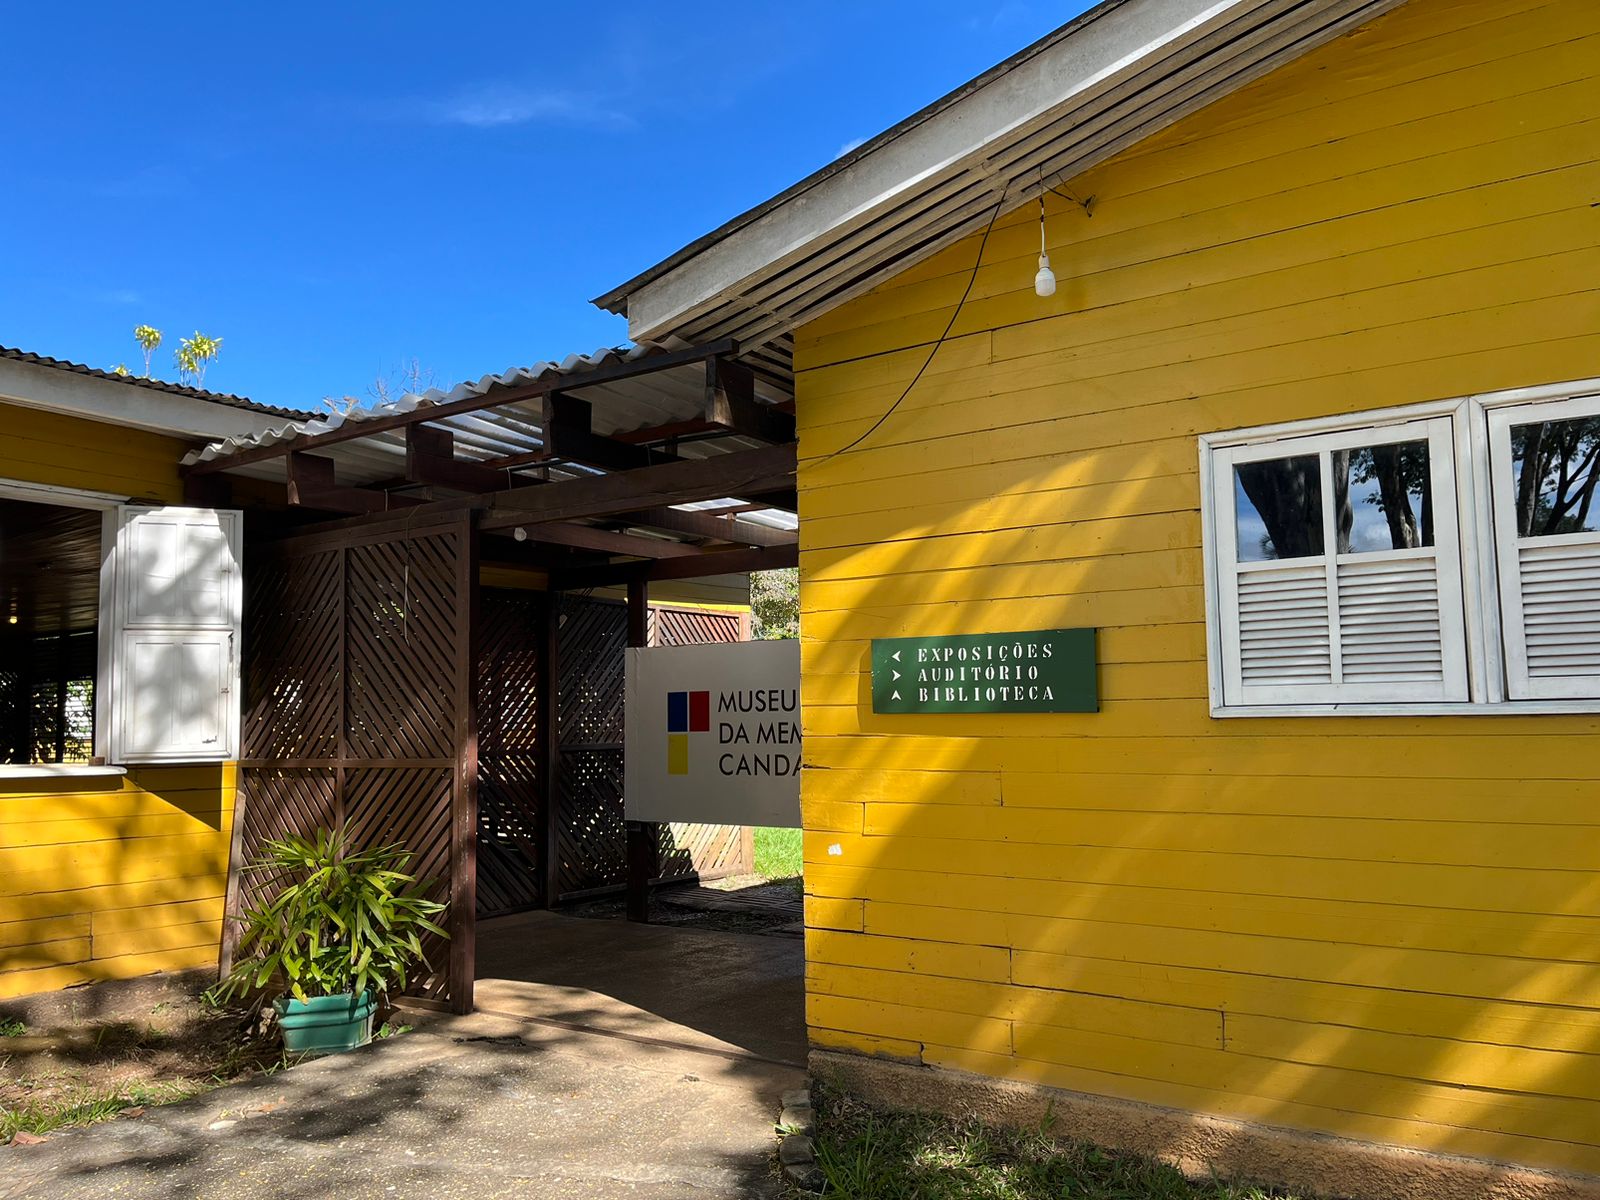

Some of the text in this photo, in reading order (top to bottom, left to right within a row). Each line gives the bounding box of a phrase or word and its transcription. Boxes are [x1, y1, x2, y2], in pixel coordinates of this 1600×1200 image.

[918, 642, 1053, 663] EXPOSIÇÕES
[918, 664, 1038, 682] AUDITÓRIO
[718, 689, 796, 712] MUSEU
[919, 685, 1054, 702] BIBLIOTECA
[719, 722, 750, 744] DA
